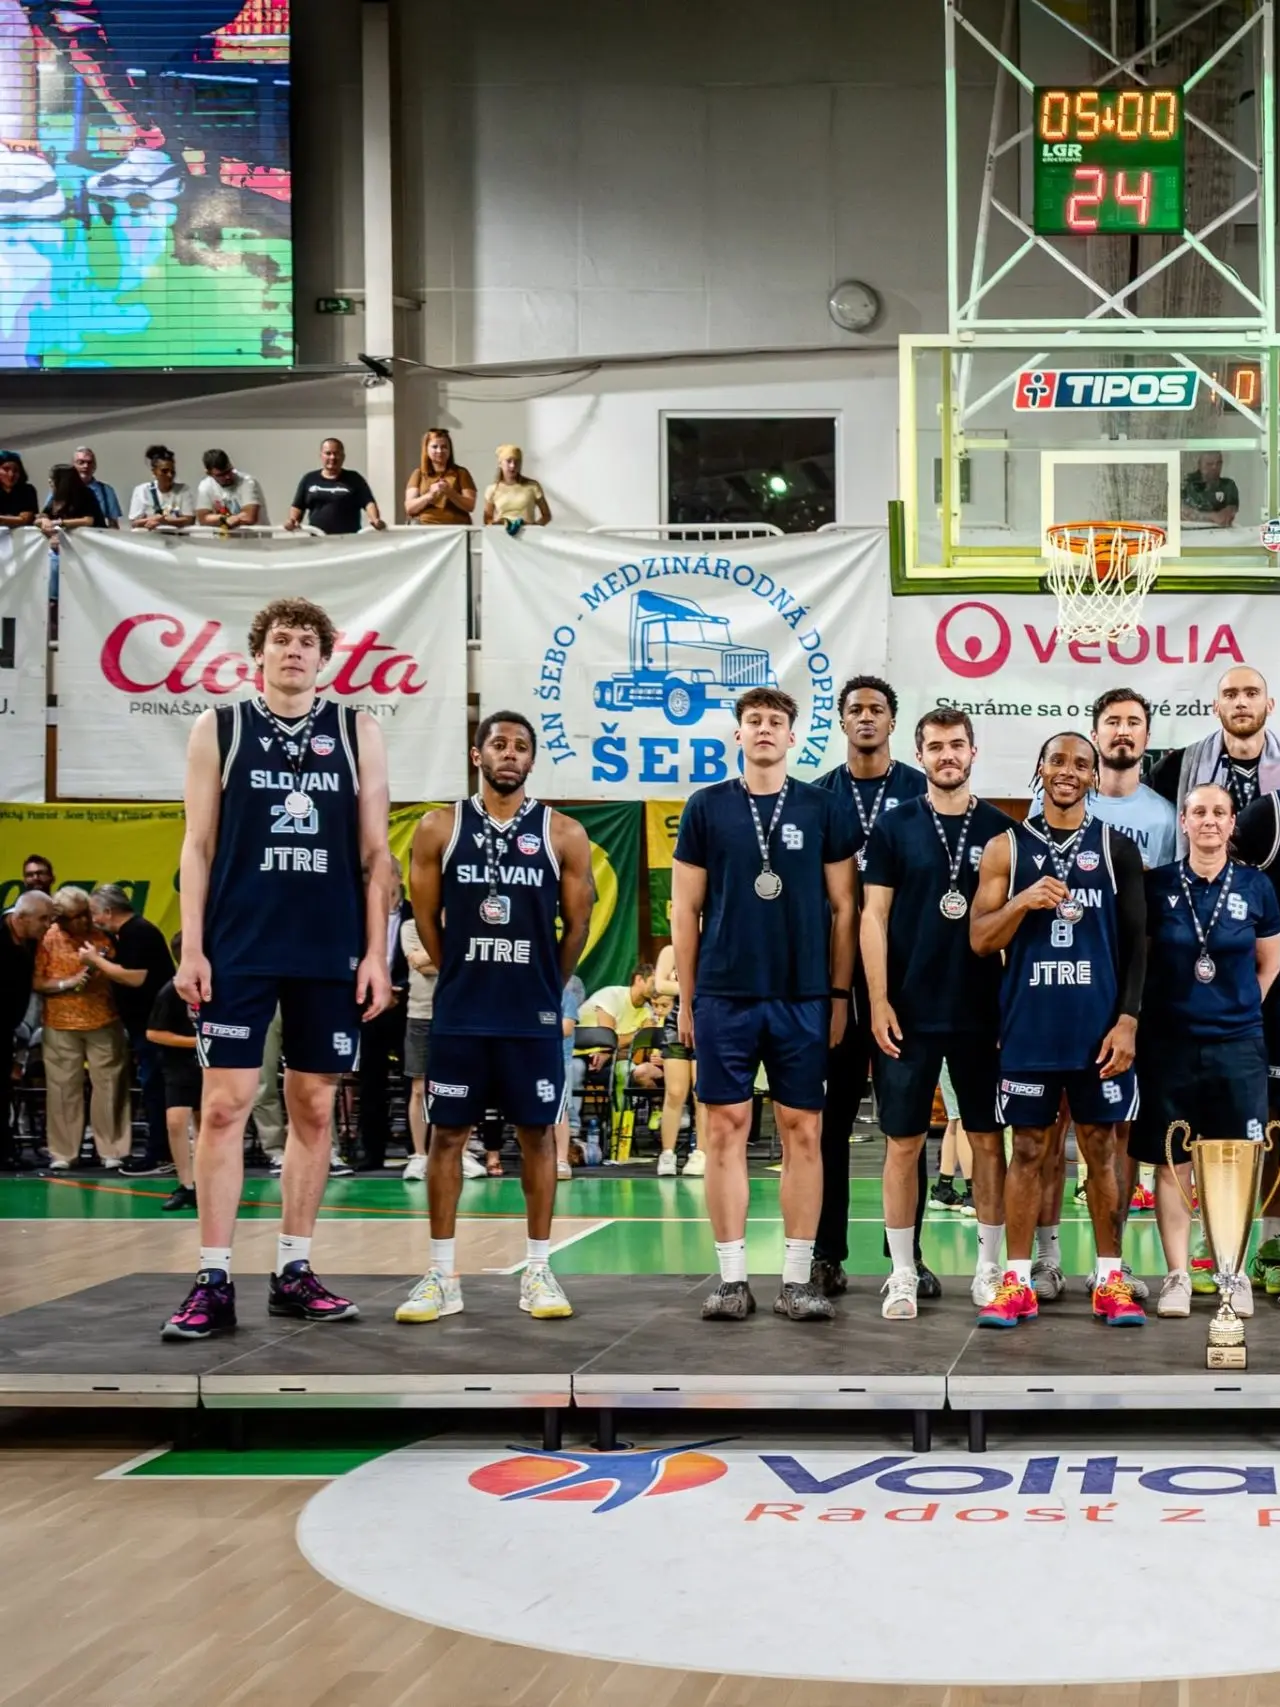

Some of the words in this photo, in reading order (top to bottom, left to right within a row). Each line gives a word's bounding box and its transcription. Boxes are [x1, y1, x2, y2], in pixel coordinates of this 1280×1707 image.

[1042, 143, 1083, 157] LGR
[1069, 169, 1150, 226] 24
[1065, 373, 1190, 405] TIPOS
[579, 552, 812, 631] MEDZINÁRODNÁ
[101, 612, 427, 695] Clota
[1023, 623, 1245, 665] VEOLIA
[532, 625, 576, 702] ŠEBO
[348, 702, 399, 717] ENTY
[796, 627, 834, 769] DOPRAVA
[935, 697, 1032, 717] Staráme
[1037, 705, 1062, 717] sa
[1066, 705, 1080, 717] o
[1175, 698, 1213, 717] zdr
[540, 711, 577, 766] JÁN
[592, 721, 745, 783] ŠEB
[260, 847, 328, 873] JTRE
[1051, 919, 1073, 948] 8
[465, 937, 532, 964] JTRE
[1029, 960, 1092, 987] JTRE
[211, 1026, 247, 1037] TIPOS
[435, 1085, 467, 1096] TIPOS
[1009, 1083, 1042, 1095] TIPOS
[744, 1501, 1118, 1522] Radosť
[1160, 1507, 1207, 1522] z
